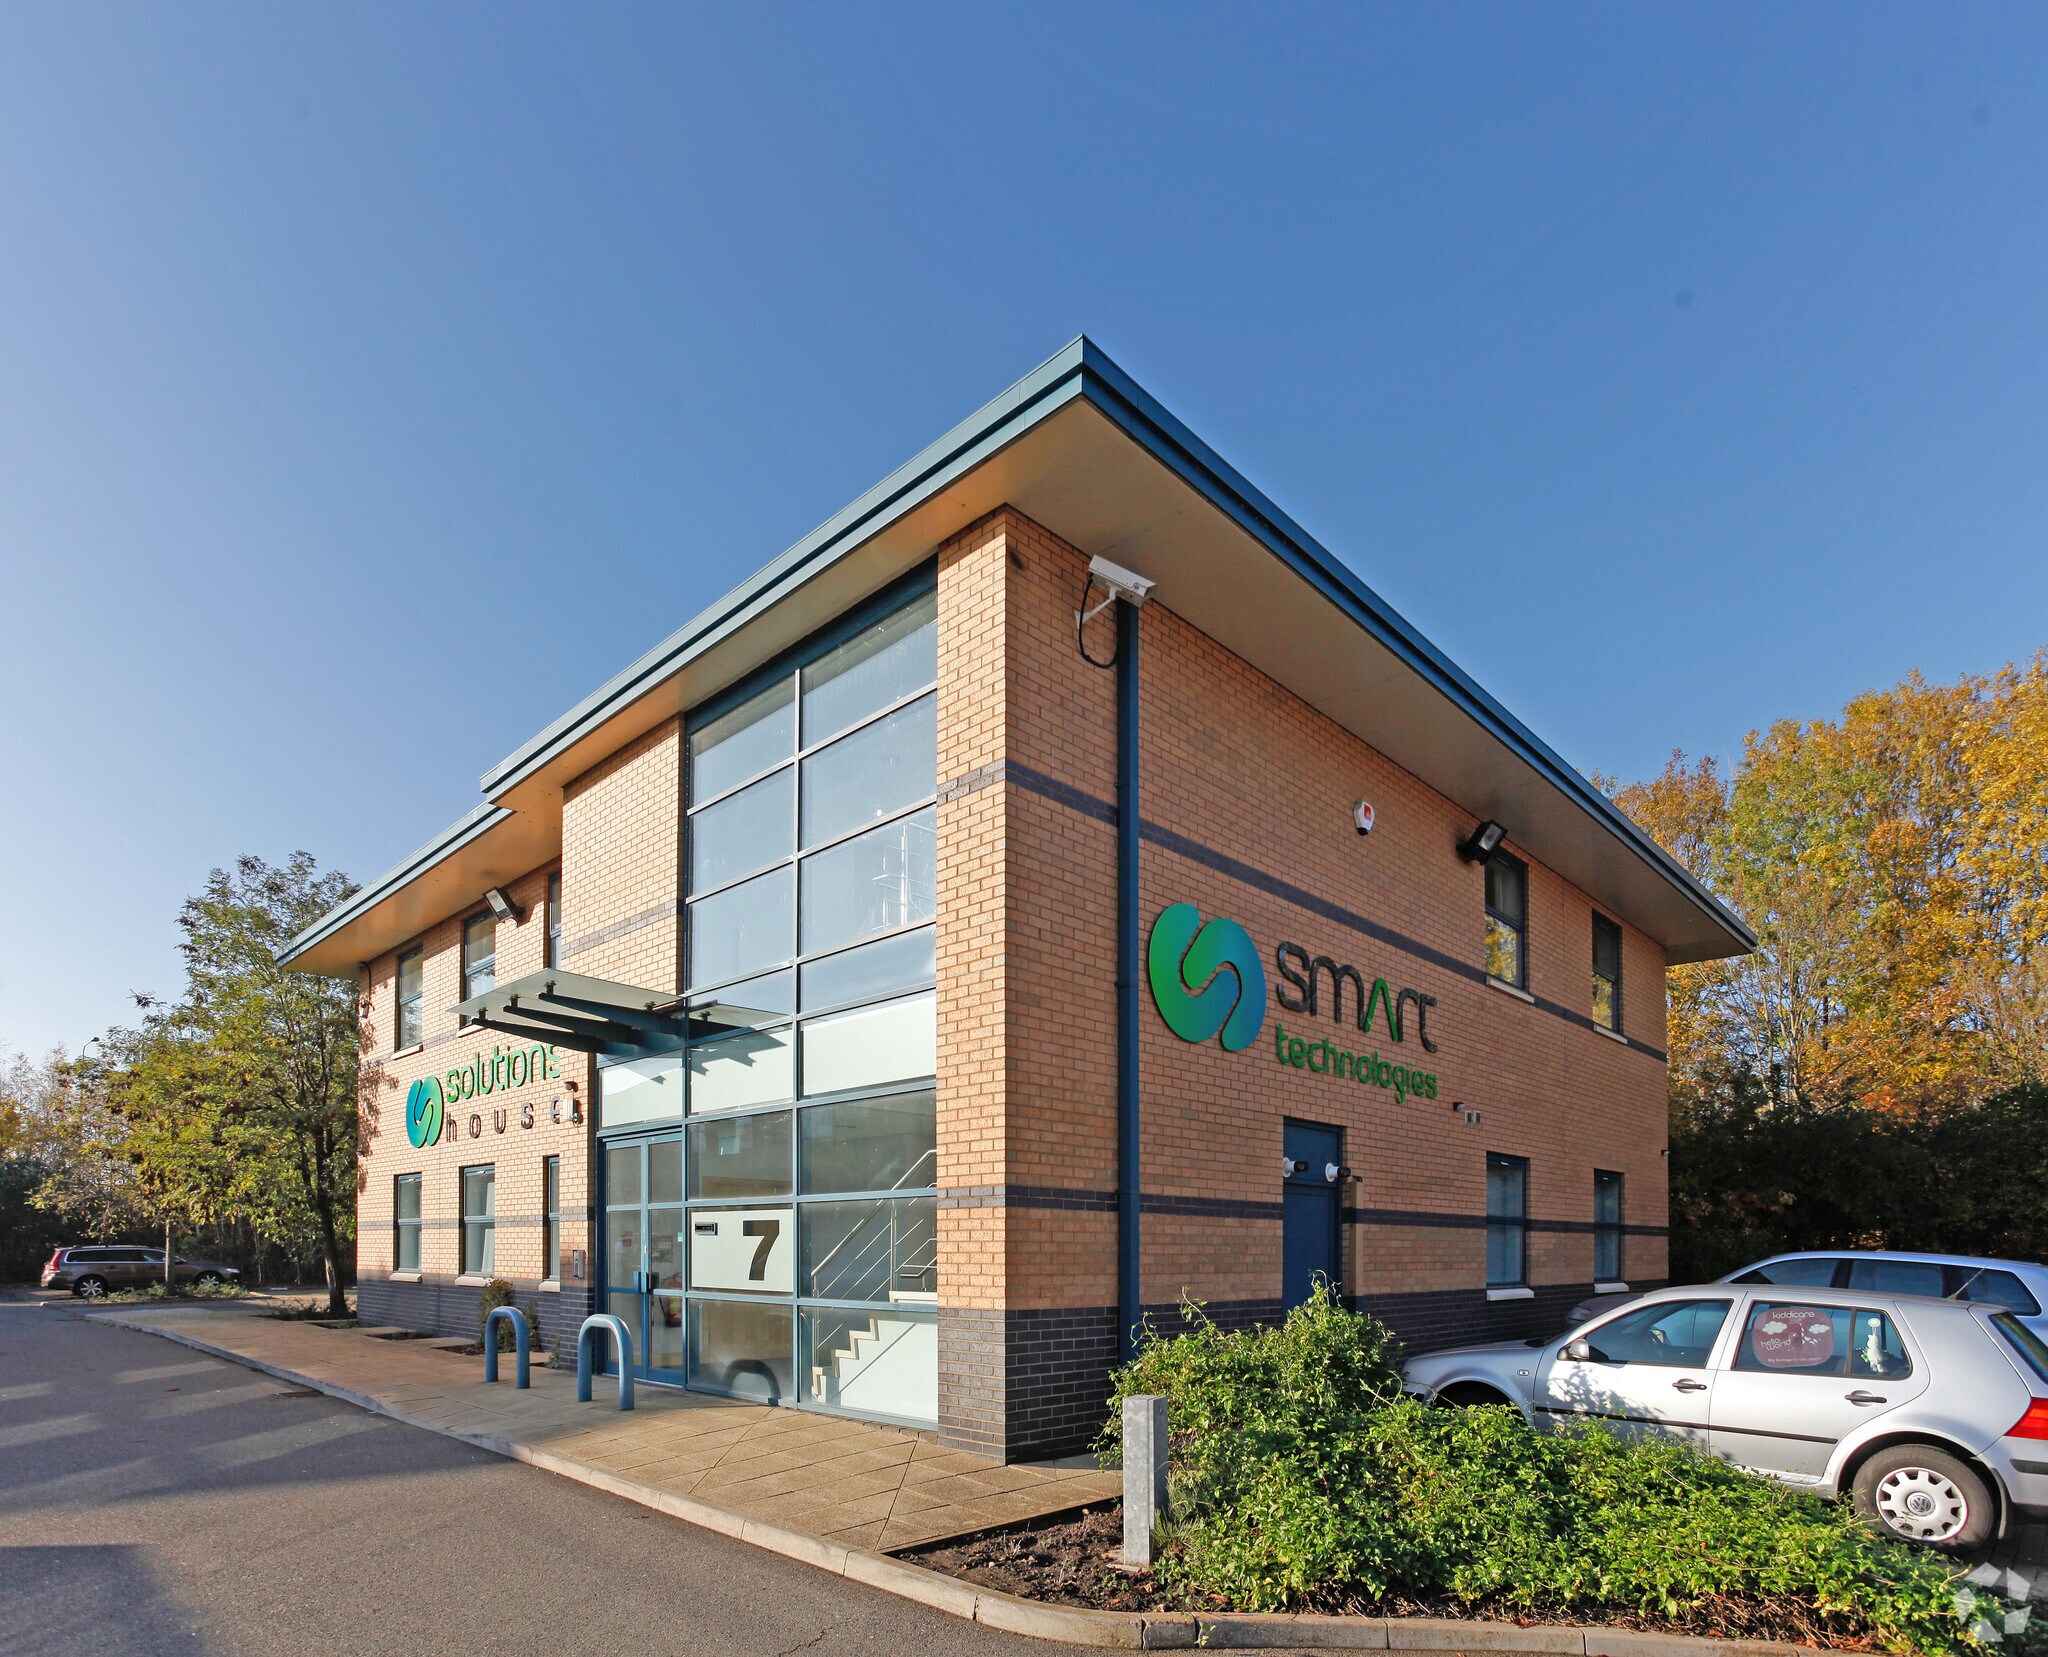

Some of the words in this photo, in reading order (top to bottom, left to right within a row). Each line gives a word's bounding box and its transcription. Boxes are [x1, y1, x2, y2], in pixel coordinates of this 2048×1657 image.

[446, 1044, 560, 1103] solutions
[1276, 1023, 1439, 1103] technologies
[742, 1219, 780, 1281] 7
[1772, 1311, 1815, 1319] kiddicare
[1760, 1338, 1780, 1348] hello
[1766, 1338, 1791, 1351] world
